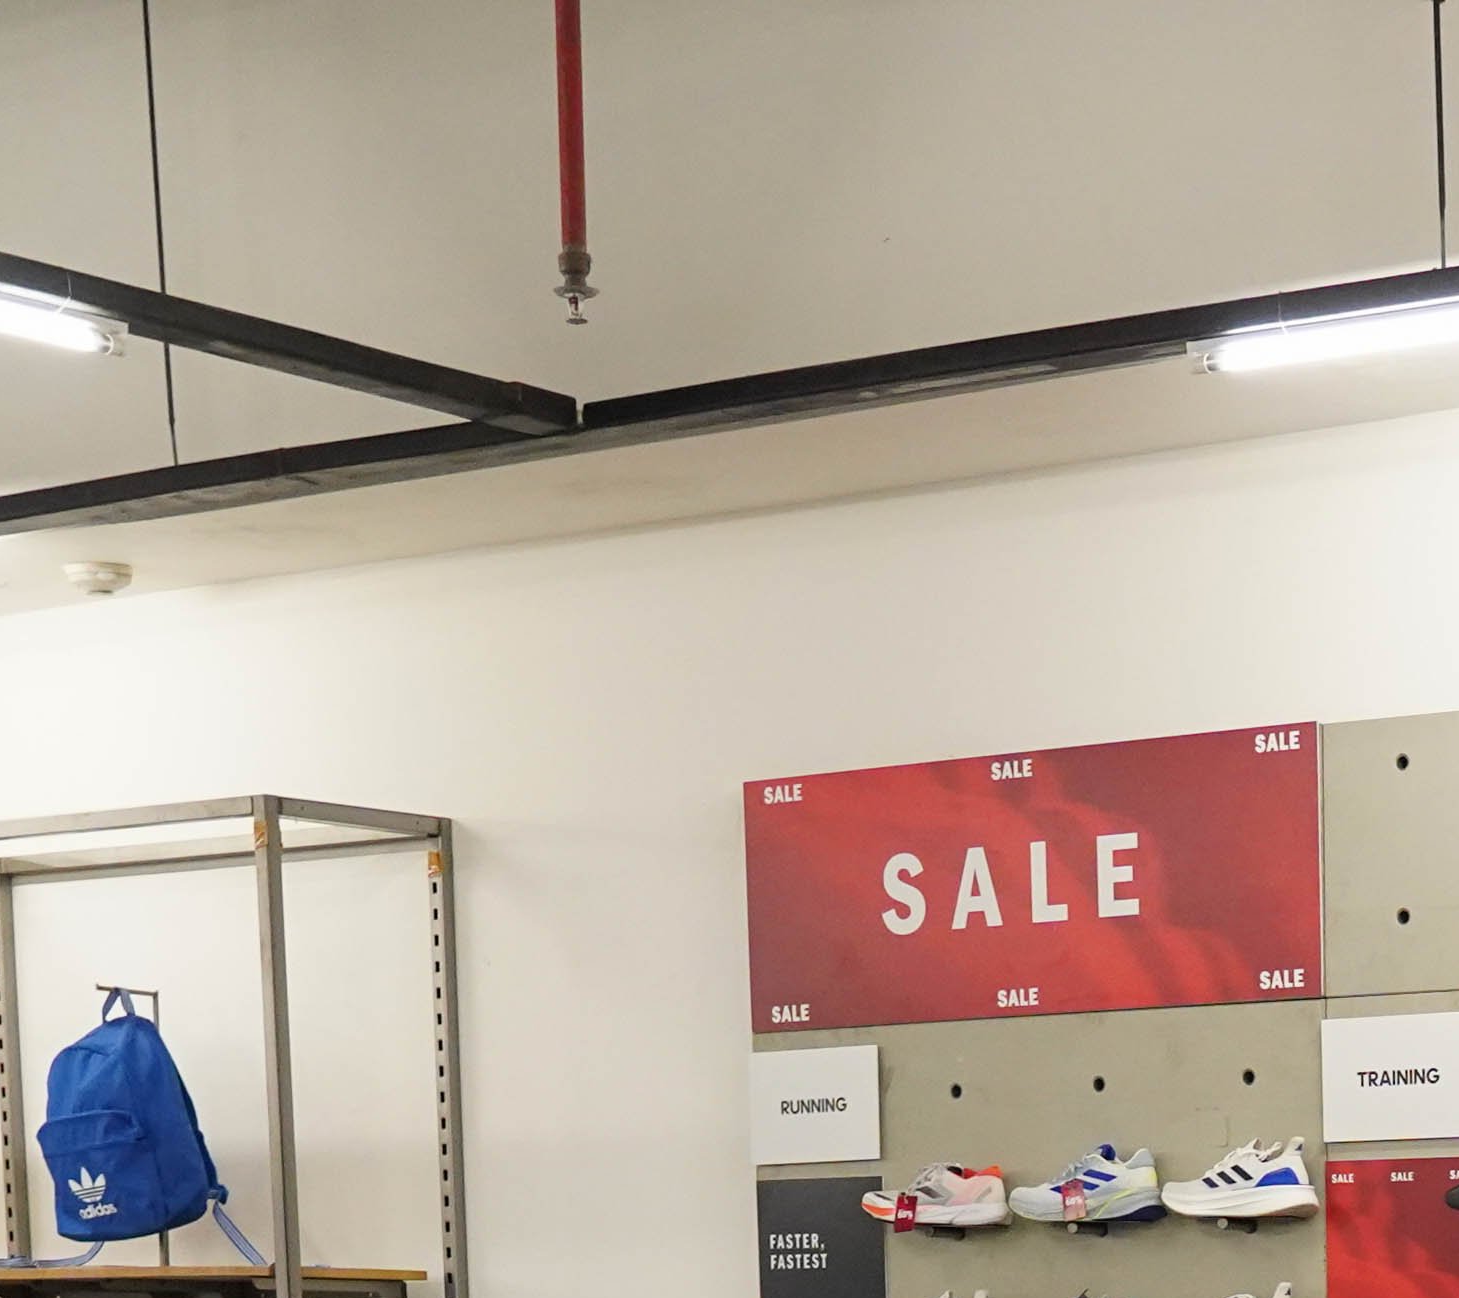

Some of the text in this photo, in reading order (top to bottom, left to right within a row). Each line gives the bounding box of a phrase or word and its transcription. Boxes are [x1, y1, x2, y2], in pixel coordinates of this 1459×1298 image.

[763, 730, 1301, 805] SALE SALE SALE
[881, 832, 1140, 935] SALE
[771, 968, 1305, 1024] SALE SALE SALE
[1357, 1068, 1440, 1087] TRAINING
[780, 1096, 847, 1115] RUNNING
[1331, 1172, 1354, 1184] SALE
[1390, 1170, 1414, 1182] SALE
[769, 1233, 825, 1250] FASTER,
[770, 1253, 827, 1270] FASTEST
